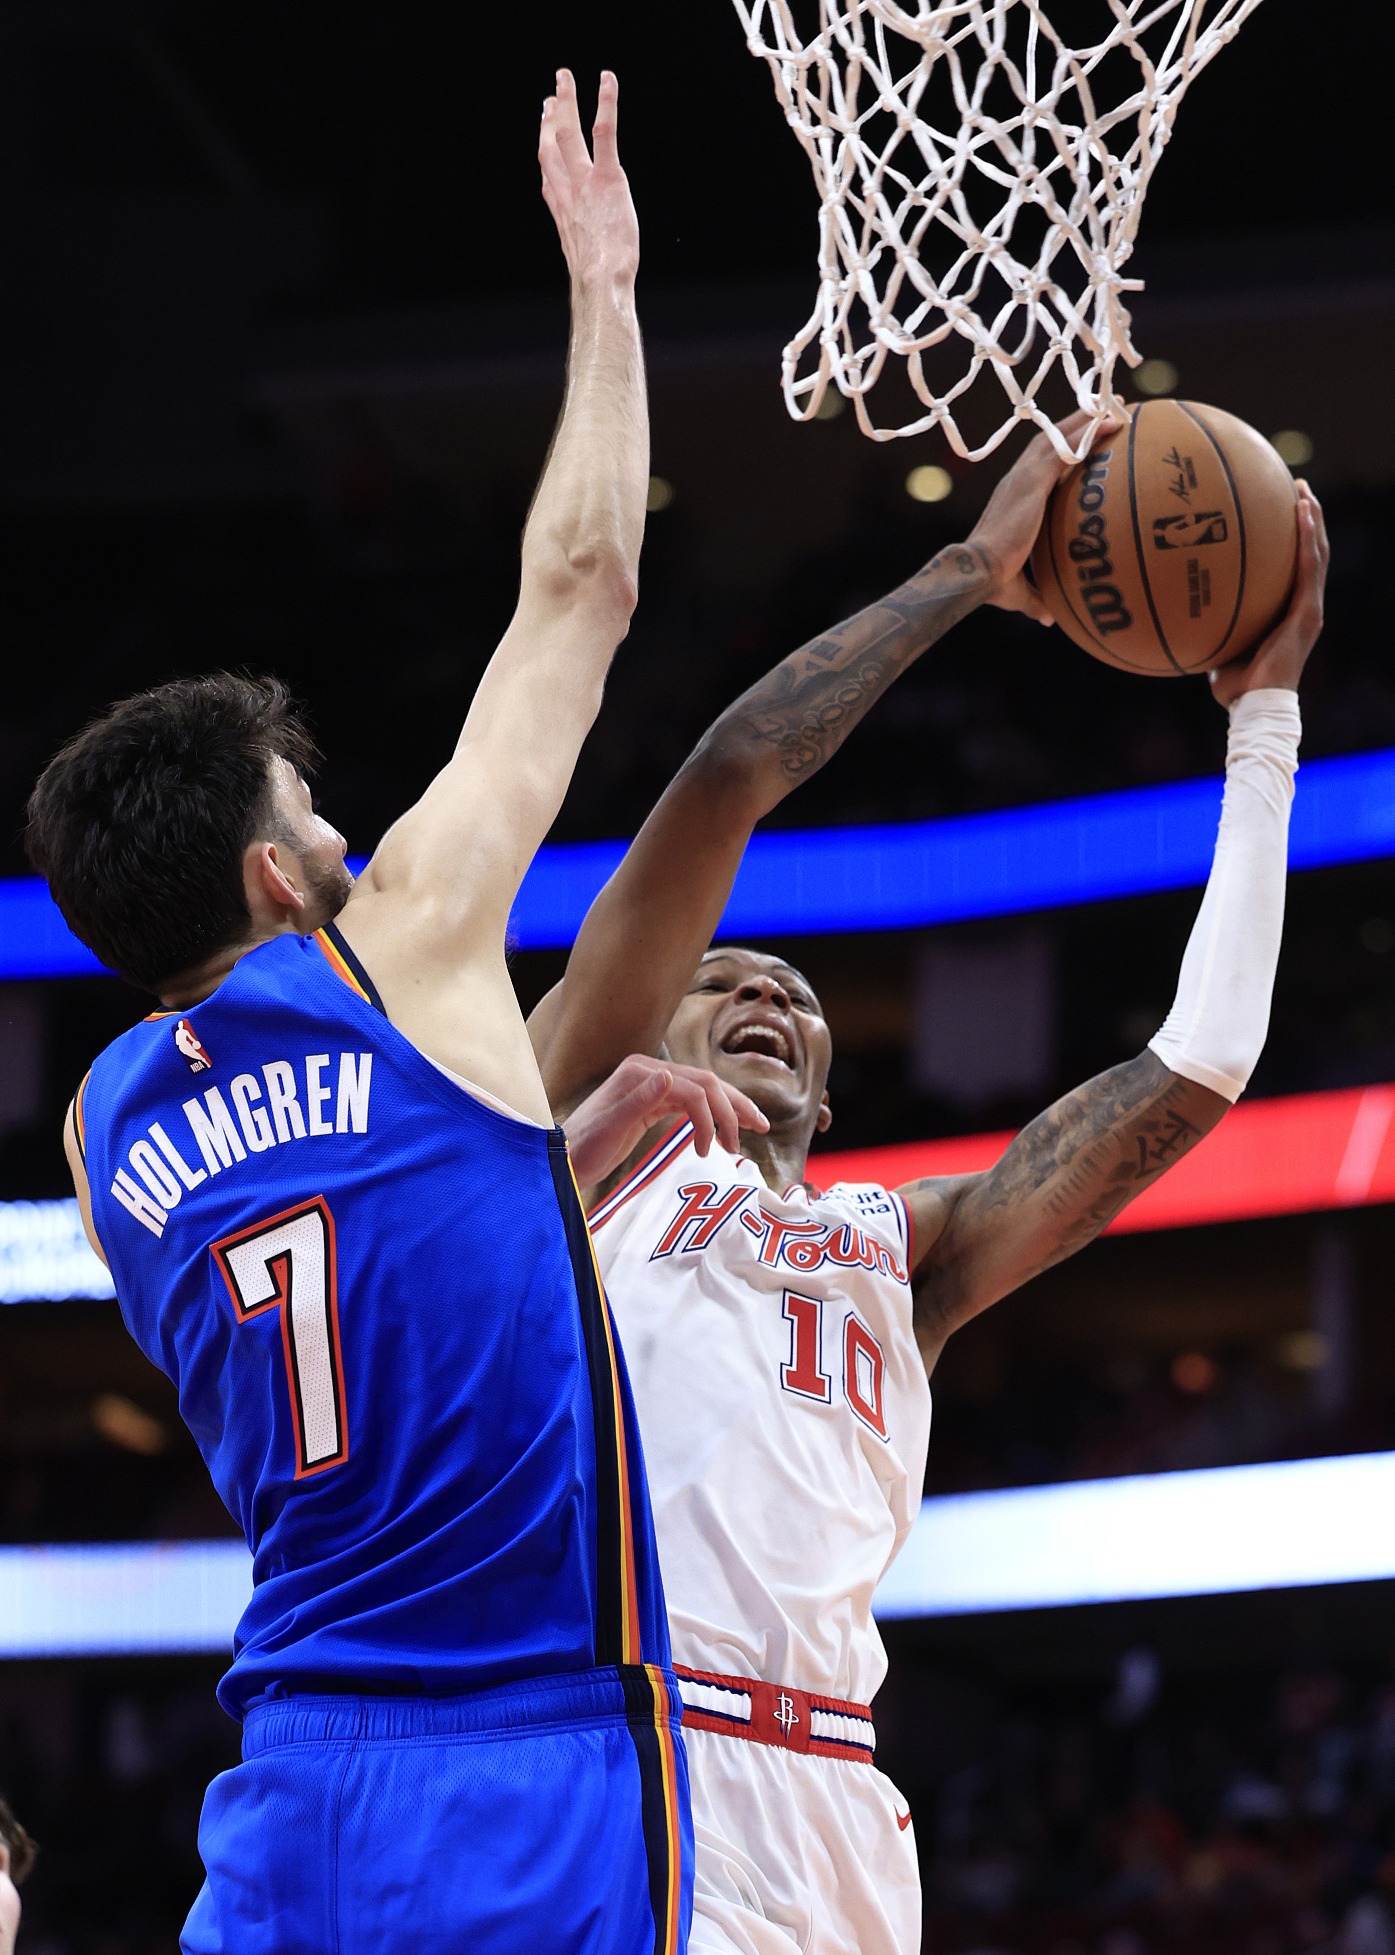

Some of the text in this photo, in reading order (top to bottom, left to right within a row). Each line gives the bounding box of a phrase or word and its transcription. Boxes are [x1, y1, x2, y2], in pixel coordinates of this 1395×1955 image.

[1069, 448, 1133, 636] Wilson
[110, 1052, 373, 1239] HOLMGREN
[648, 1181, 910, 1286] H-Town
[209, 1194, 349, 1481] 7
[780, 1288, 891, 1443] 10
